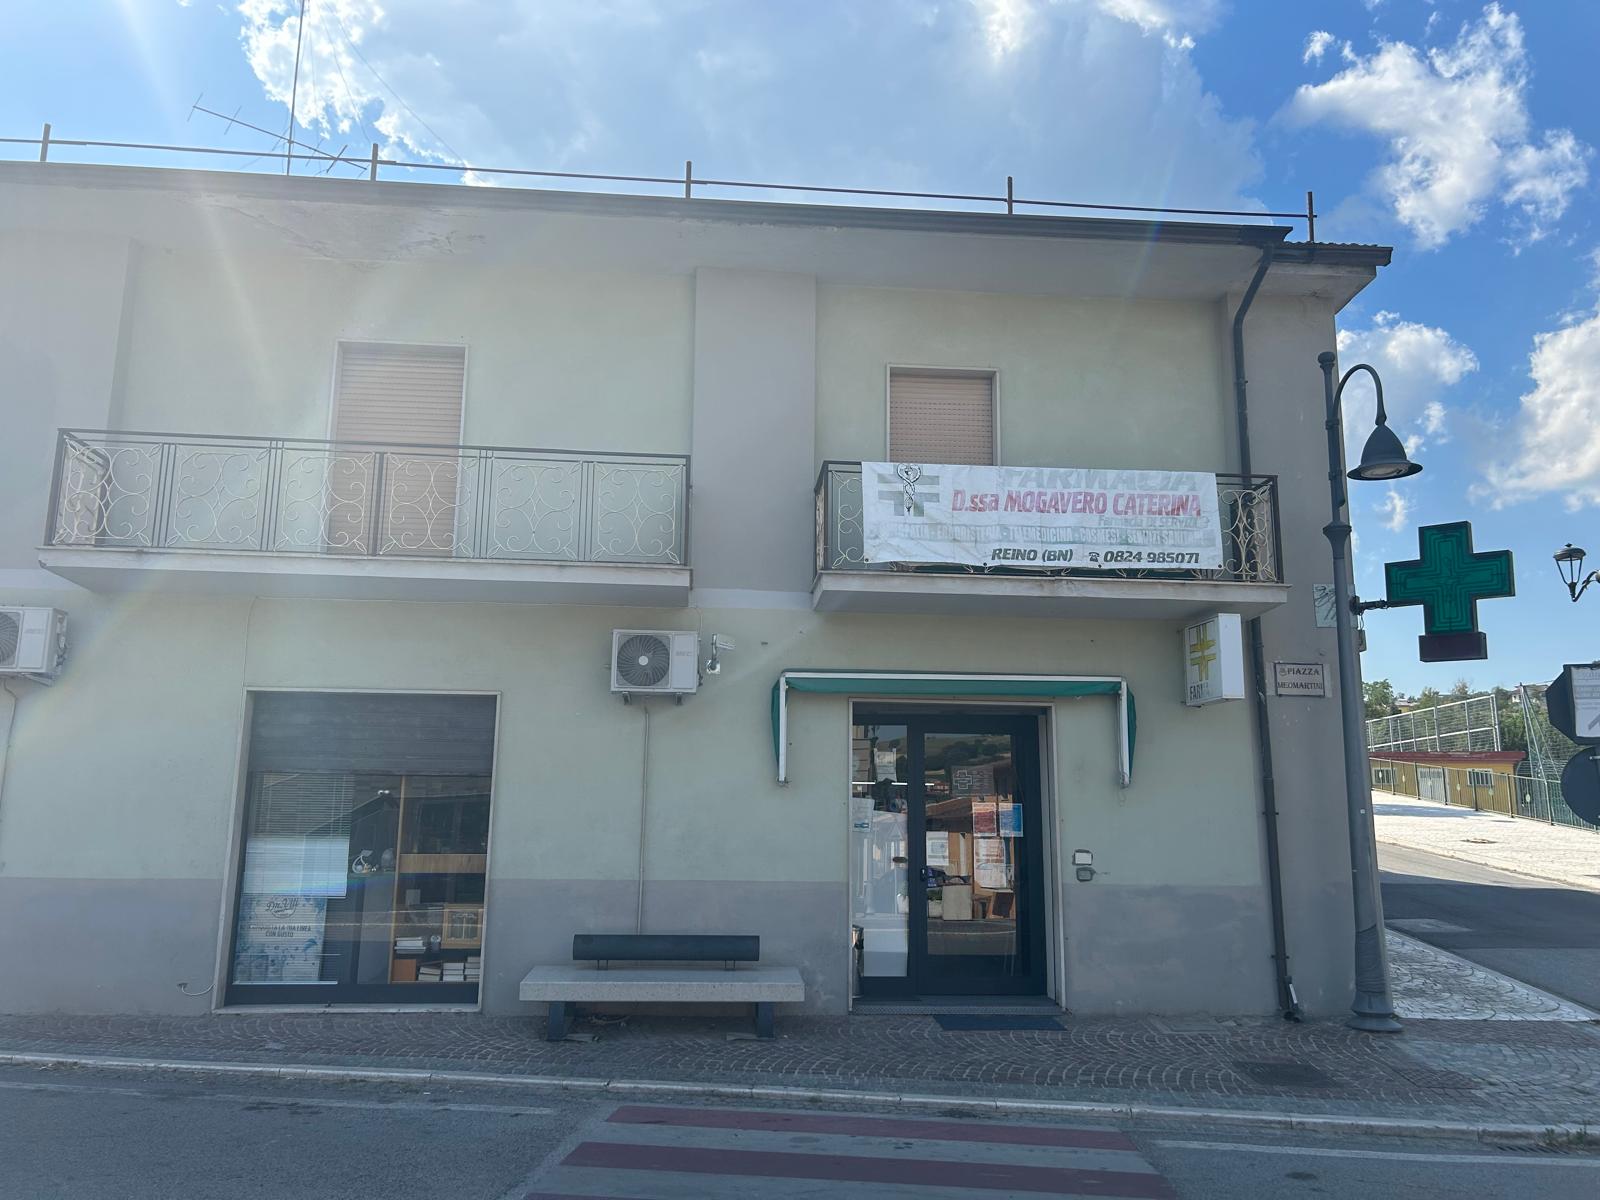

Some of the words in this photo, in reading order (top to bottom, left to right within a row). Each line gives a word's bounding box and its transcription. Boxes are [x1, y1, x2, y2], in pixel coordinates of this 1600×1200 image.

[951, 488, 999, 513] D.ssa
[1003, 489, 1107, 515] MOGAVERO
[1112, 493, 1202, 517] CATERINA
[991, 548, 1038, 561] REINO
[1041, 549, 1073, 562] (BN)
[1103, 550, 1143, 563] 0824
[1146, 552, 1200, 564] 985071
[1287, 668, 1320, 676] PIAZZA
